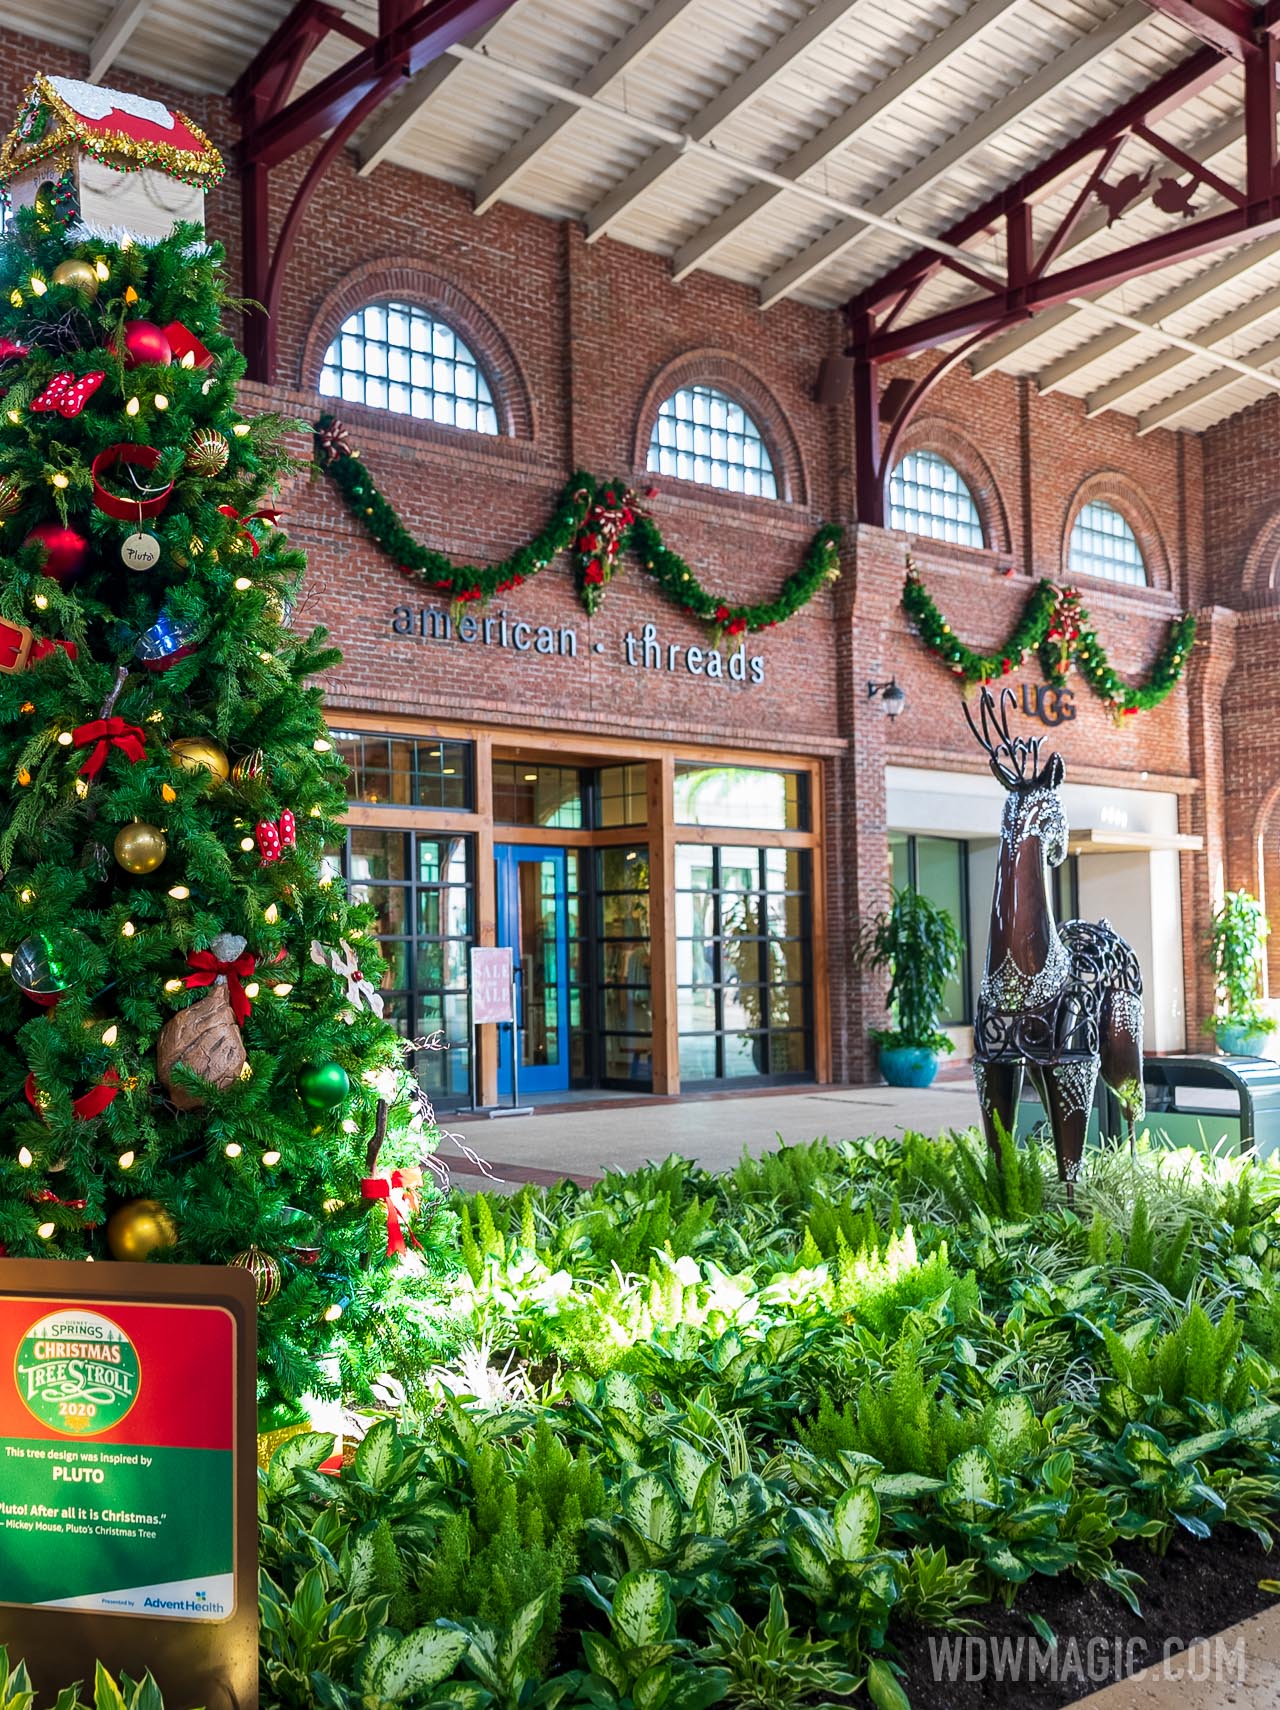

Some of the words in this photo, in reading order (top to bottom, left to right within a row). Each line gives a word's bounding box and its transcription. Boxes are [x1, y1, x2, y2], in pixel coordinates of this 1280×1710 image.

[127, 548, 154, 562] Pluto
[392, 604, 578, 659] american
[625, 622, 766, 685] threads
[1021, 684, 1077, 727] UGG
[51, 1324, 103, 1340] SPRINGS
[33, 1341, 121, 1364] CHRISTMAS
[59, 1402, 96, 1416] 2020
[5, 1446, 25, 1458] This
[26, 1449, 45, 1459] tree
[47, 1449, 79, 1463] design
[80, 1453, 98, 1462] was
[100, 1452, 138, 1466] inspired
[140, 1455, 152, 1468] by
[52, 1466, 105, 1484] PLUTO
[29, 1505, 58, 1518] After
[61, 1508, 76, 1519] all
[78, 1508, 87, 1520] it
[89, 1509, 99, 1521] is
[5, 1519, 34, 1532] Mickey
[35, 1522, 64, 1534] Mouse,
[95, 1526, 137, 1538] Christmas
[138, 1529, 157, 1539] Tree
[143, 1597, 224, 1613] AdventHealth
